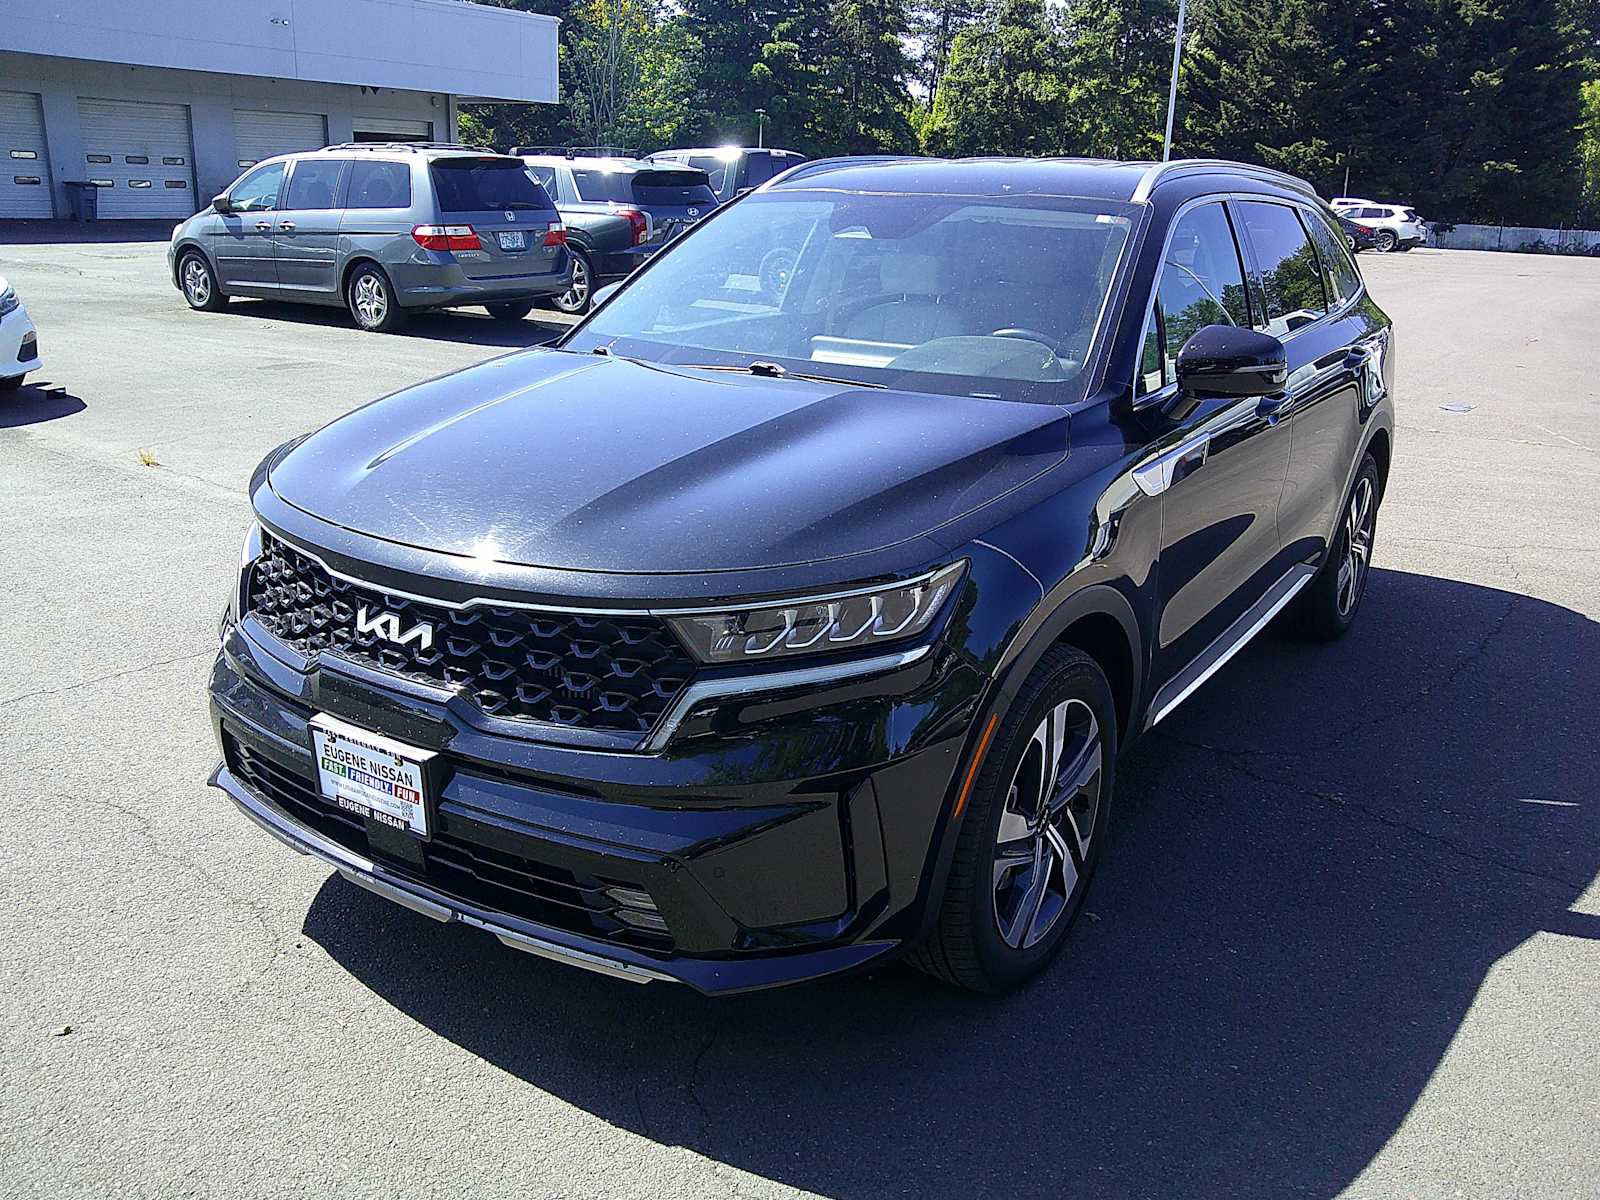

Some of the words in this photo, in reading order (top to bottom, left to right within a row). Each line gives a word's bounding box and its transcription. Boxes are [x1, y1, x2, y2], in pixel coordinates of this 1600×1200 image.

[323, 744, 367, 770] EUGENE
[369, 761, 413, 787] NISSAN
[323, 759, 345, 776] FAST.
[350, 768, 392, 794] FRIENDLY.
[397, 787, 419, 803] FUN.
[338, 798, 370, 818] EUGENE
[374, 810, 405, 831] NISSAN
